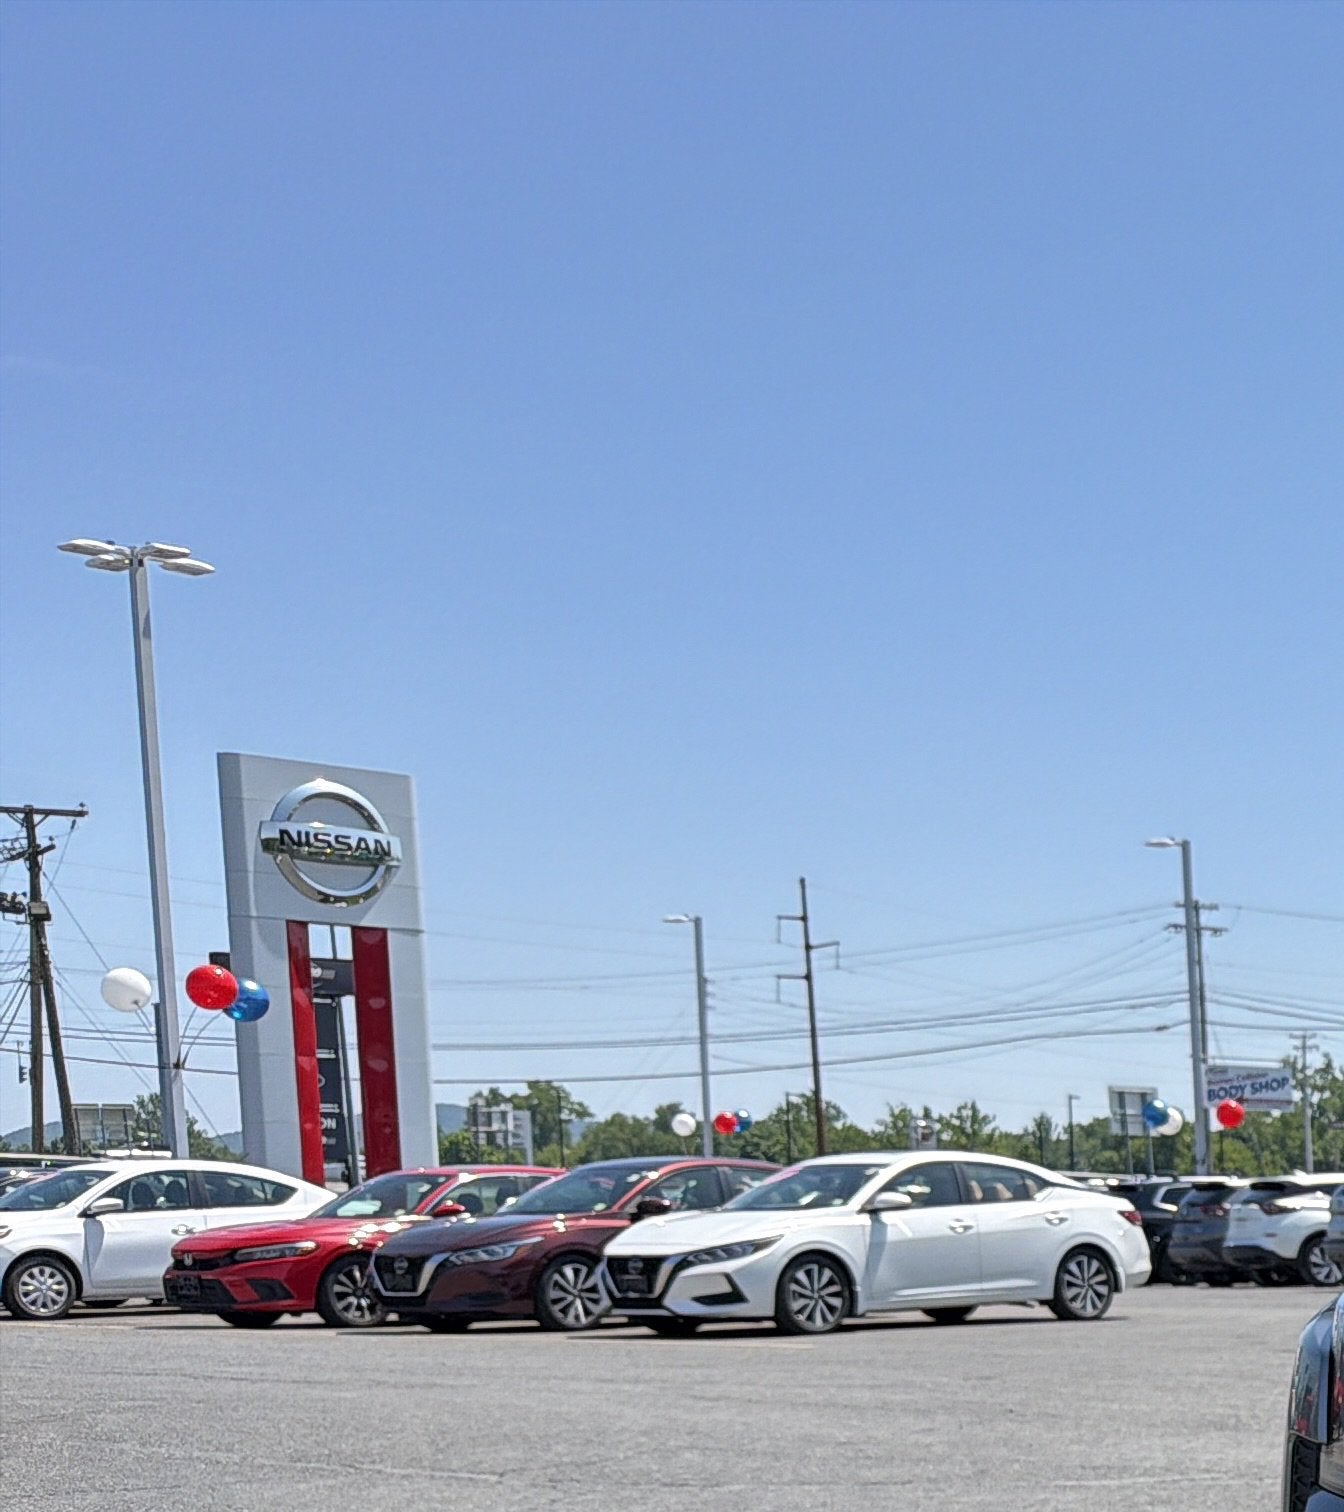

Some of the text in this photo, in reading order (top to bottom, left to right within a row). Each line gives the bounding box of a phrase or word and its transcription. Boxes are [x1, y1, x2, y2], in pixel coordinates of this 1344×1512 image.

[278, 829, 392, 857] NISSAN
[1207, 1084, 1247, 1102] BODY
[1250, 1077, 1290, 1095] SHOP
